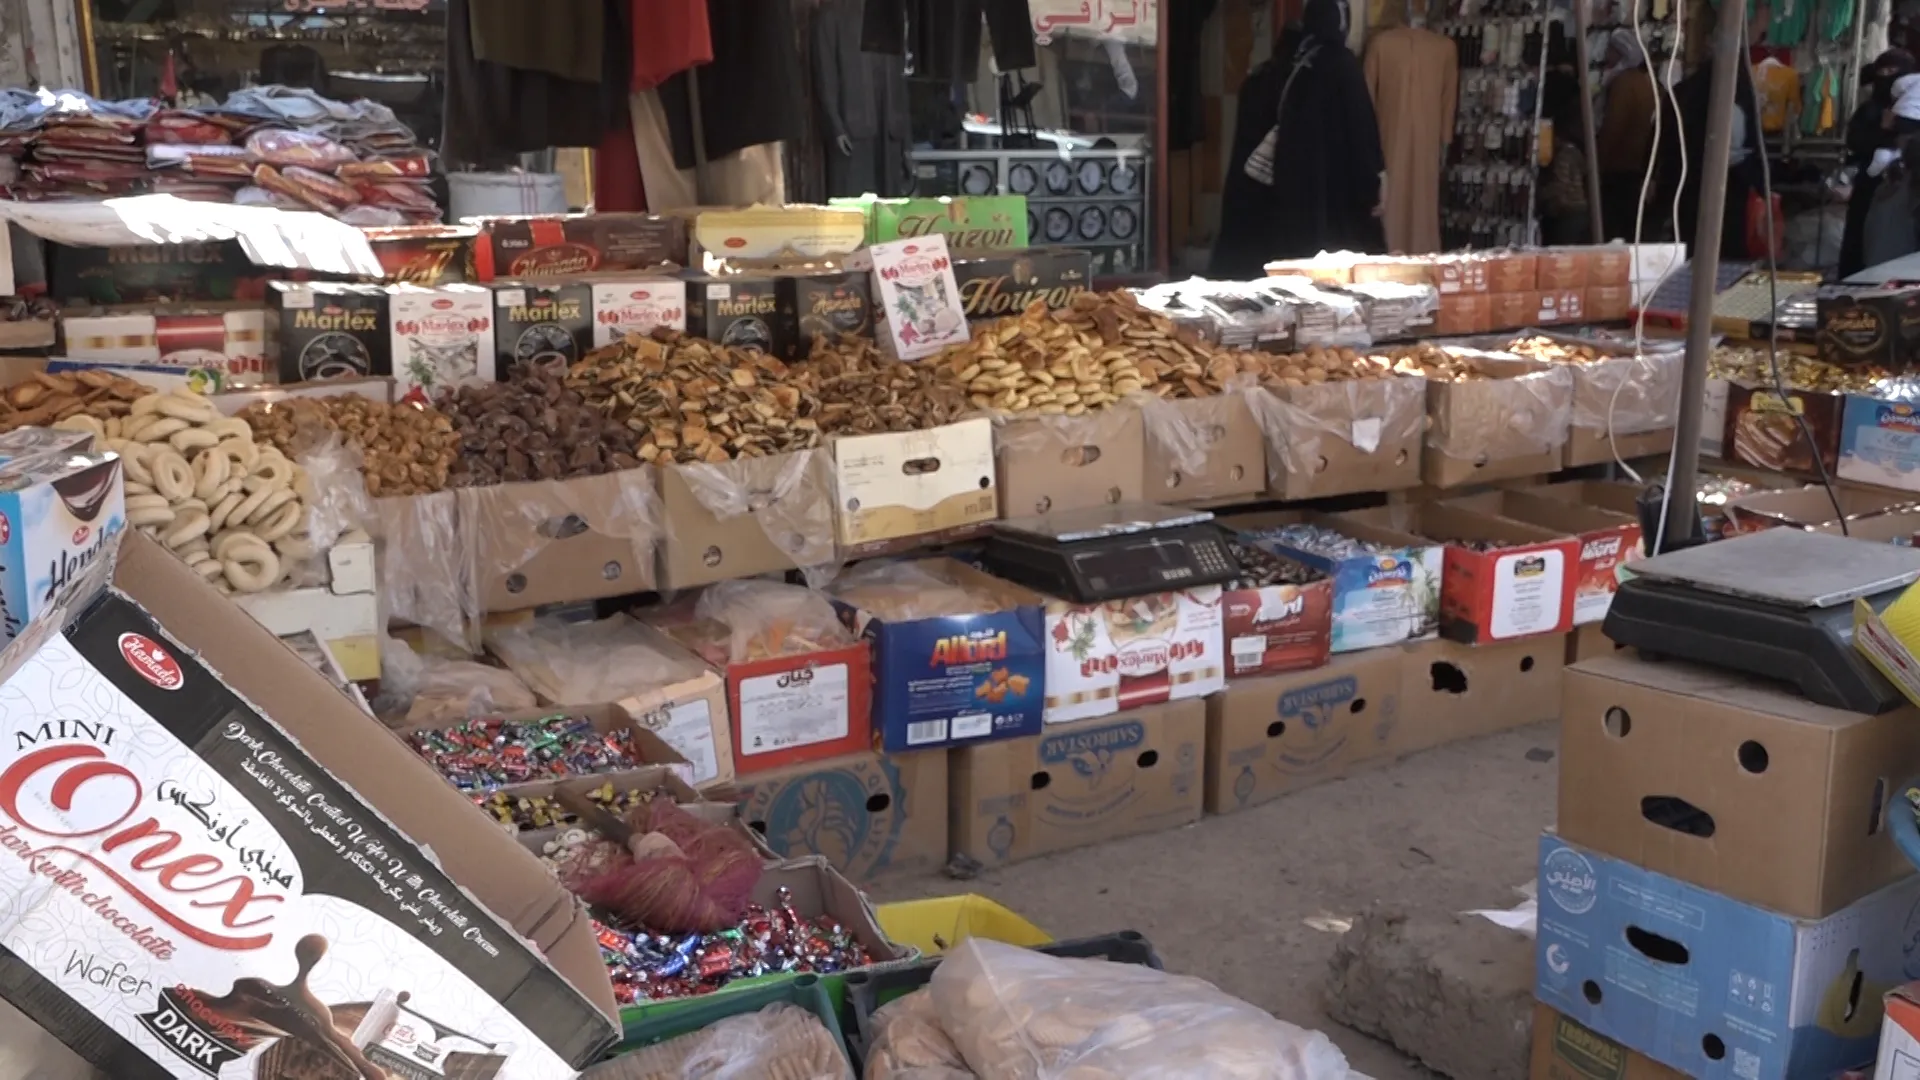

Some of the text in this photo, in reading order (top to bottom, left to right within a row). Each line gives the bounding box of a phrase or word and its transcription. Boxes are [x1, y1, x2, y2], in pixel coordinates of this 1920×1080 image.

[897, 213, 1016, 249] Hrizon
[294, 308, 378, 331] Marlex
[508, 302, 581, 323] Marlex
[717, 297, 777, 317] Marlex
[123, 636, 178, 688] Hamada
[15, 718, 117, 752] MINI
[222, 721, 264, 756] Dark
[0, 743, 285, 932] Onex
[156, 778, 295, 890] ميني أونكس
[80, 890, 178, 961] chocolate
[63, 949, 153, 997] Wafer
[152, 1008, 221, 1066] DARK
